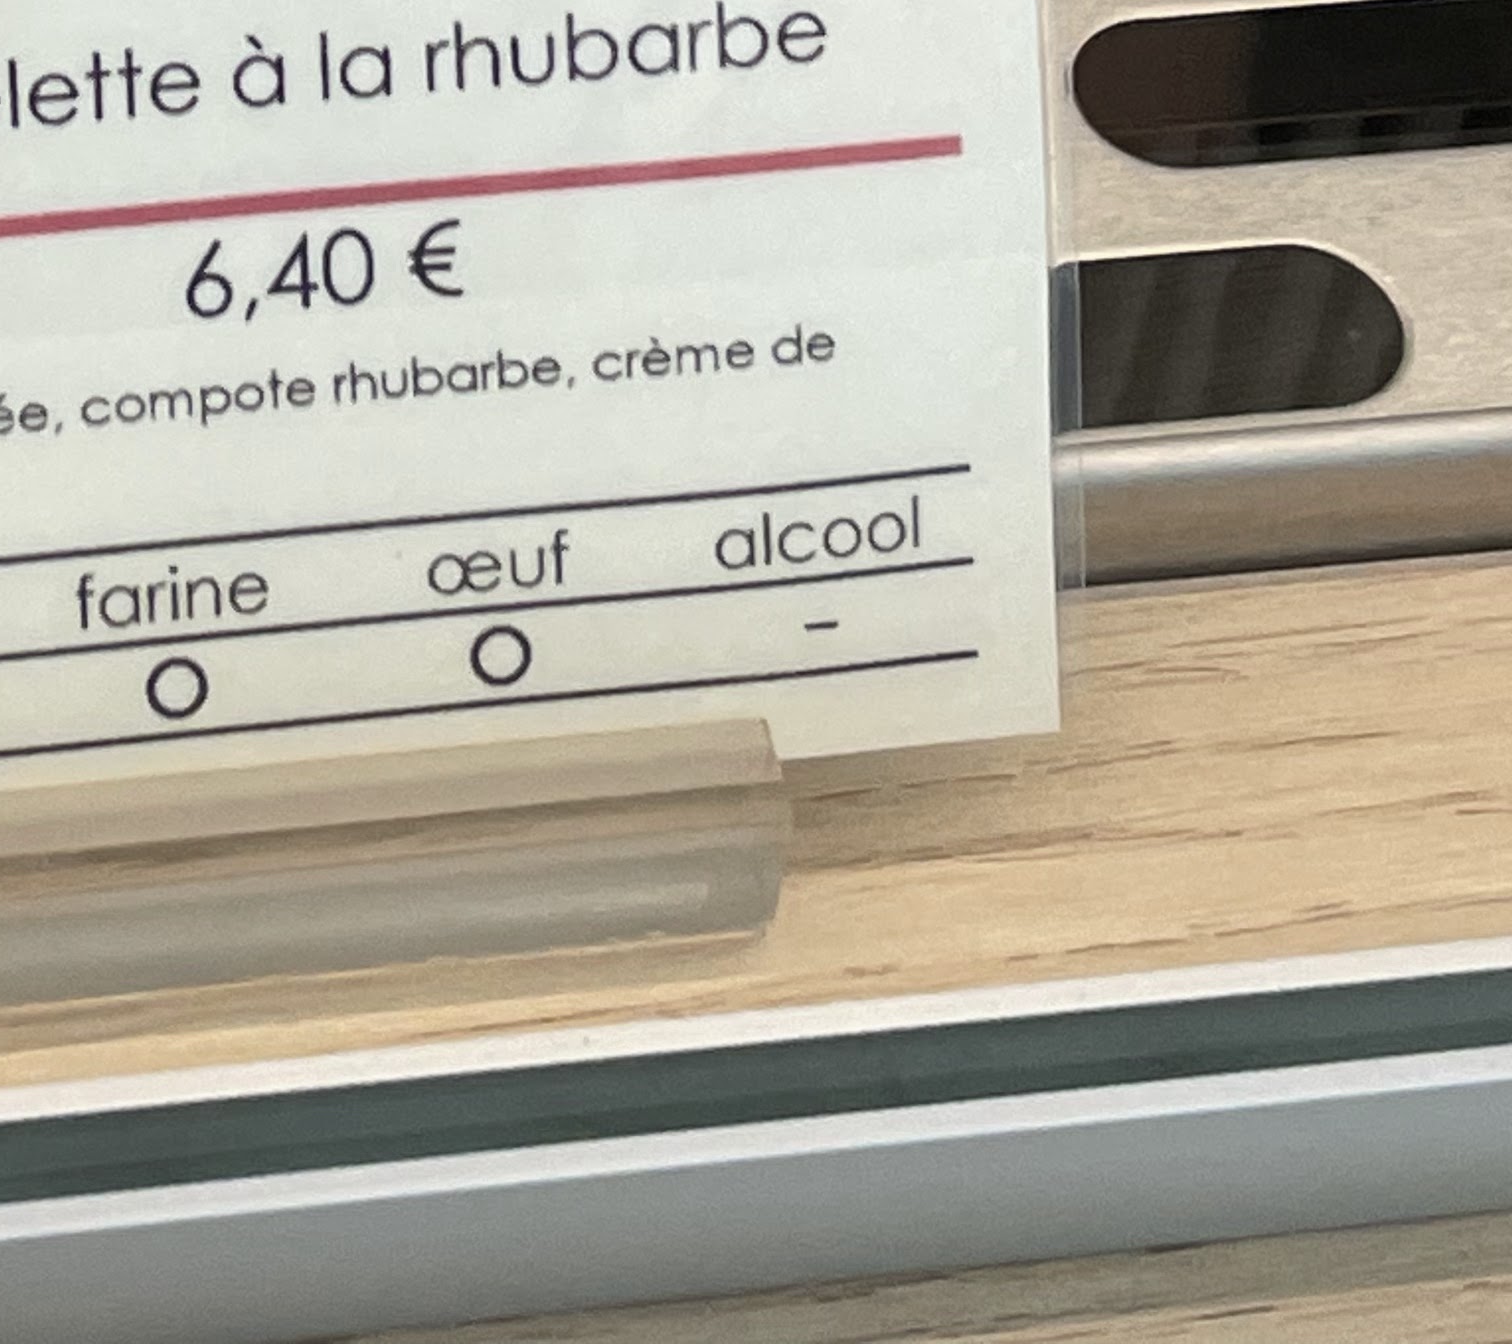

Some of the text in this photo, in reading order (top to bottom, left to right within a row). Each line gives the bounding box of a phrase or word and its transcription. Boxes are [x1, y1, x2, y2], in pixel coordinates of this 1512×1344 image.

[232, 34, 287, 110] à
[318, 30, 393, 103] la
[424, 0, 828, 94] rhubarbe
[185, 217, 465, 323] 6,40 €
[80, 368, 316, 428] compote
[332, 348, 575, 405] rhubarbe,
[591, 336, 755, 383] crème
[770, 323, 836, 367] de
[75, 564, 270, 631] farine
[426, 528, 570, 597] œuf
[714, 494, 921, 571] alcool
